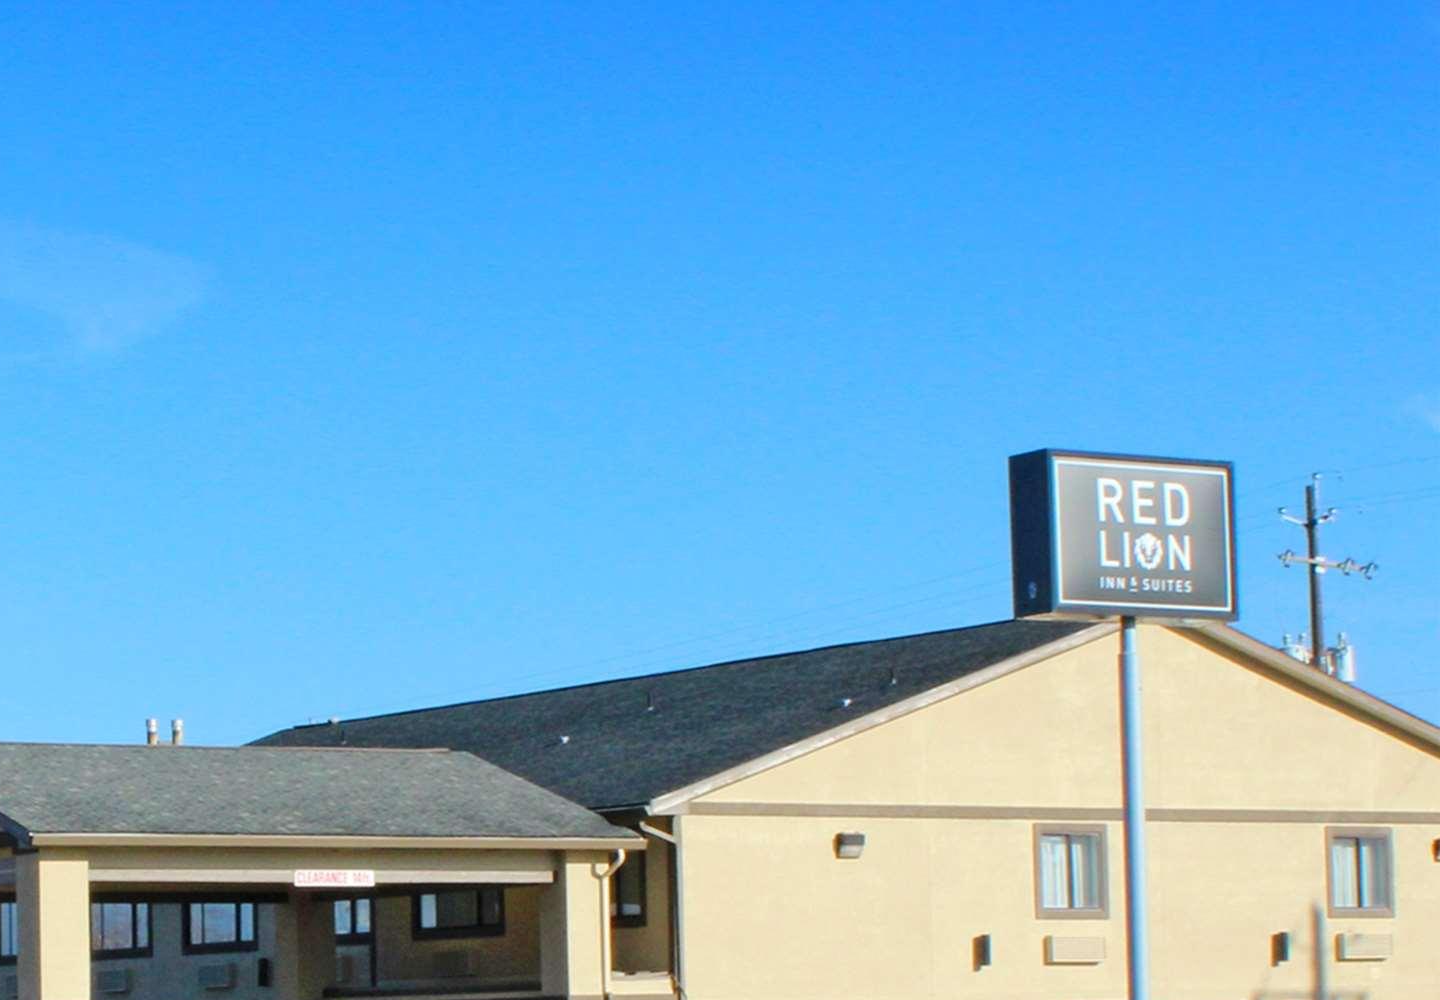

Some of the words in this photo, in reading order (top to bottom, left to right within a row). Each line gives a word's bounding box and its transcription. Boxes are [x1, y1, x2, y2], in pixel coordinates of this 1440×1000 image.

[1097, 477, 1190, 526] RED
[1100, 530, 1191, 571] LION
[1100, 576, 1126, 589] INN
[1142, 578, 1192, 593] SUITES
